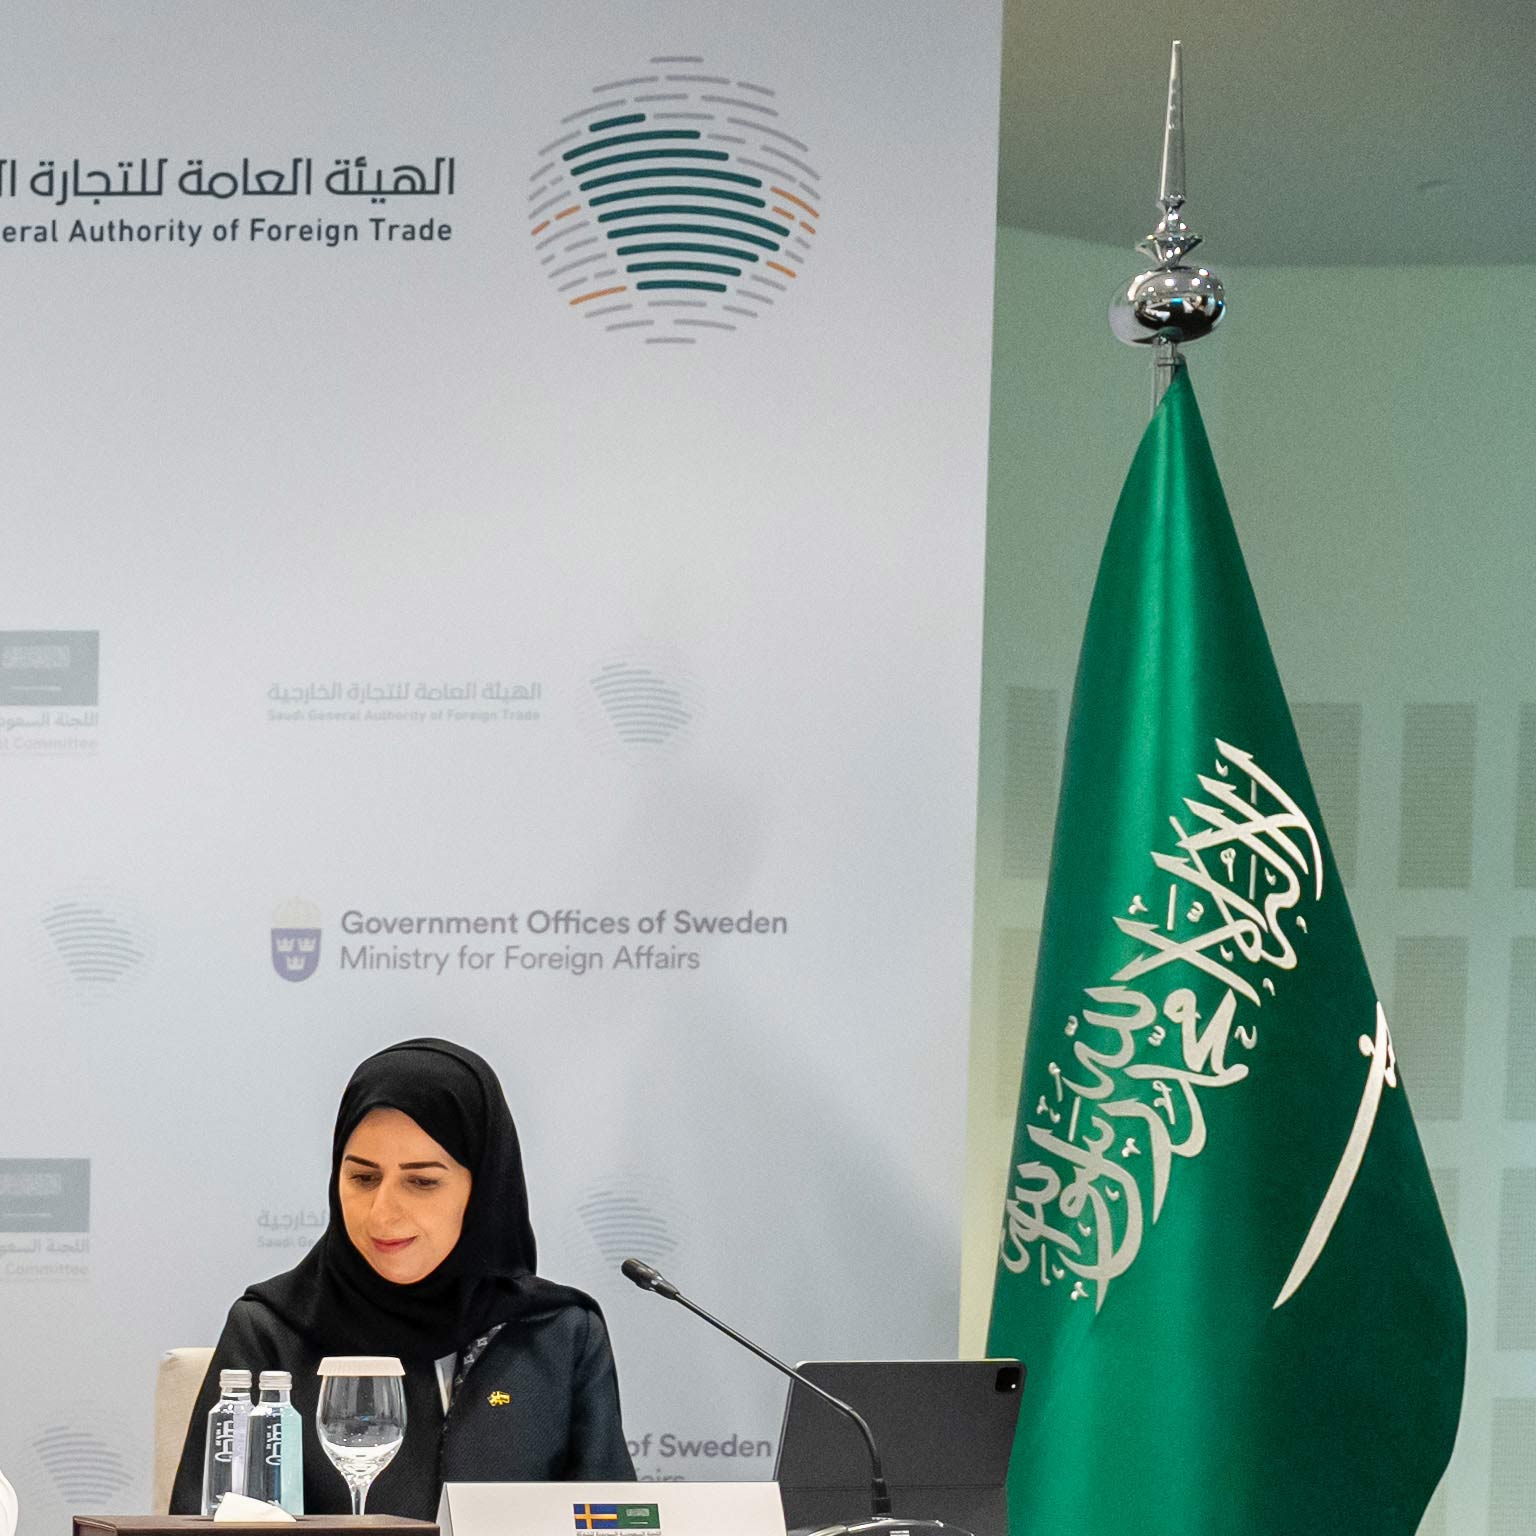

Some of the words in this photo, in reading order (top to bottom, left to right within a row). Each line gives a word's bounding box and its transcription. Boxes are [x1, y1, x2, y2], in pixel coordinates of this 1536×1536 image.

[29, 157, 169, 207] للتجارة
[177, 157, 312, 200] العامة
[324, 155, 455, 205] الهيئة
[68, 218, 203, 248] Authority
[212, 218, 240, 242] of
[249, 217, 359, 248] Foreign
[368, 217, 452, 242] Trade
[340, 909, 519, 935] Government
[526, 909, 631, 935] Offices
[637, 909, 667, 935] of
[673, 909, 788, 935] Sweden
[340, 944, 450, 976] Ministry
[457, 944, 496, 971] for
[504, 944, 604, 977] Foreign
[612, 944, 701, 971] Affairs
[627, 1433, 653, 1458] of
[658, 1432, 772, 1458] Sweden
